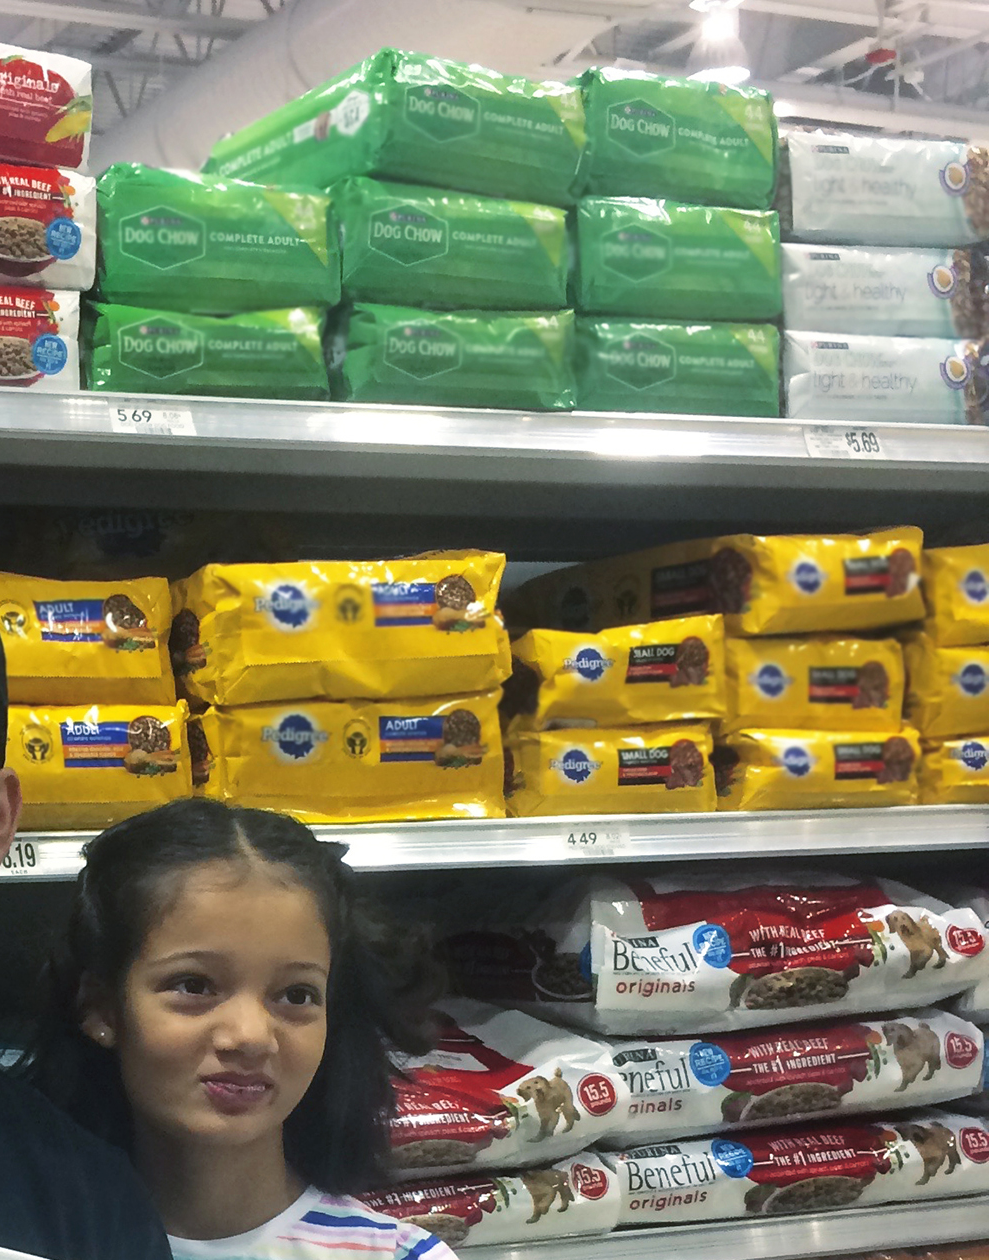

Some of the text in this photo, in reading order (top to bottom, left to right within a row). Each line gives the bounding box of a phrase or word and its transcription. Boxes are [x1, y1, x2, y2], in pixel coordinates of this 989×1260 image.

[210, 232, 298, 246] COMPLETE ADULT
[845, 432, 879, 453] $5.69
[262, 726, 328, 743] Pedigree
[386, 720, 418, 731] ADULT
[613, 937, 698, 974] Beneful
[616, 979, 695, 998] originals
[753, 1060, 769, 1074] THE
[787, 1053, 836, 1071] INGREDIENT
[583, 1080, 610, 1099] 15.5
[965, 1128, 988, 1148] 15.5
[627, 1151, 716, 1190] Beneful
[630, 1188, 708, 1210] originals
